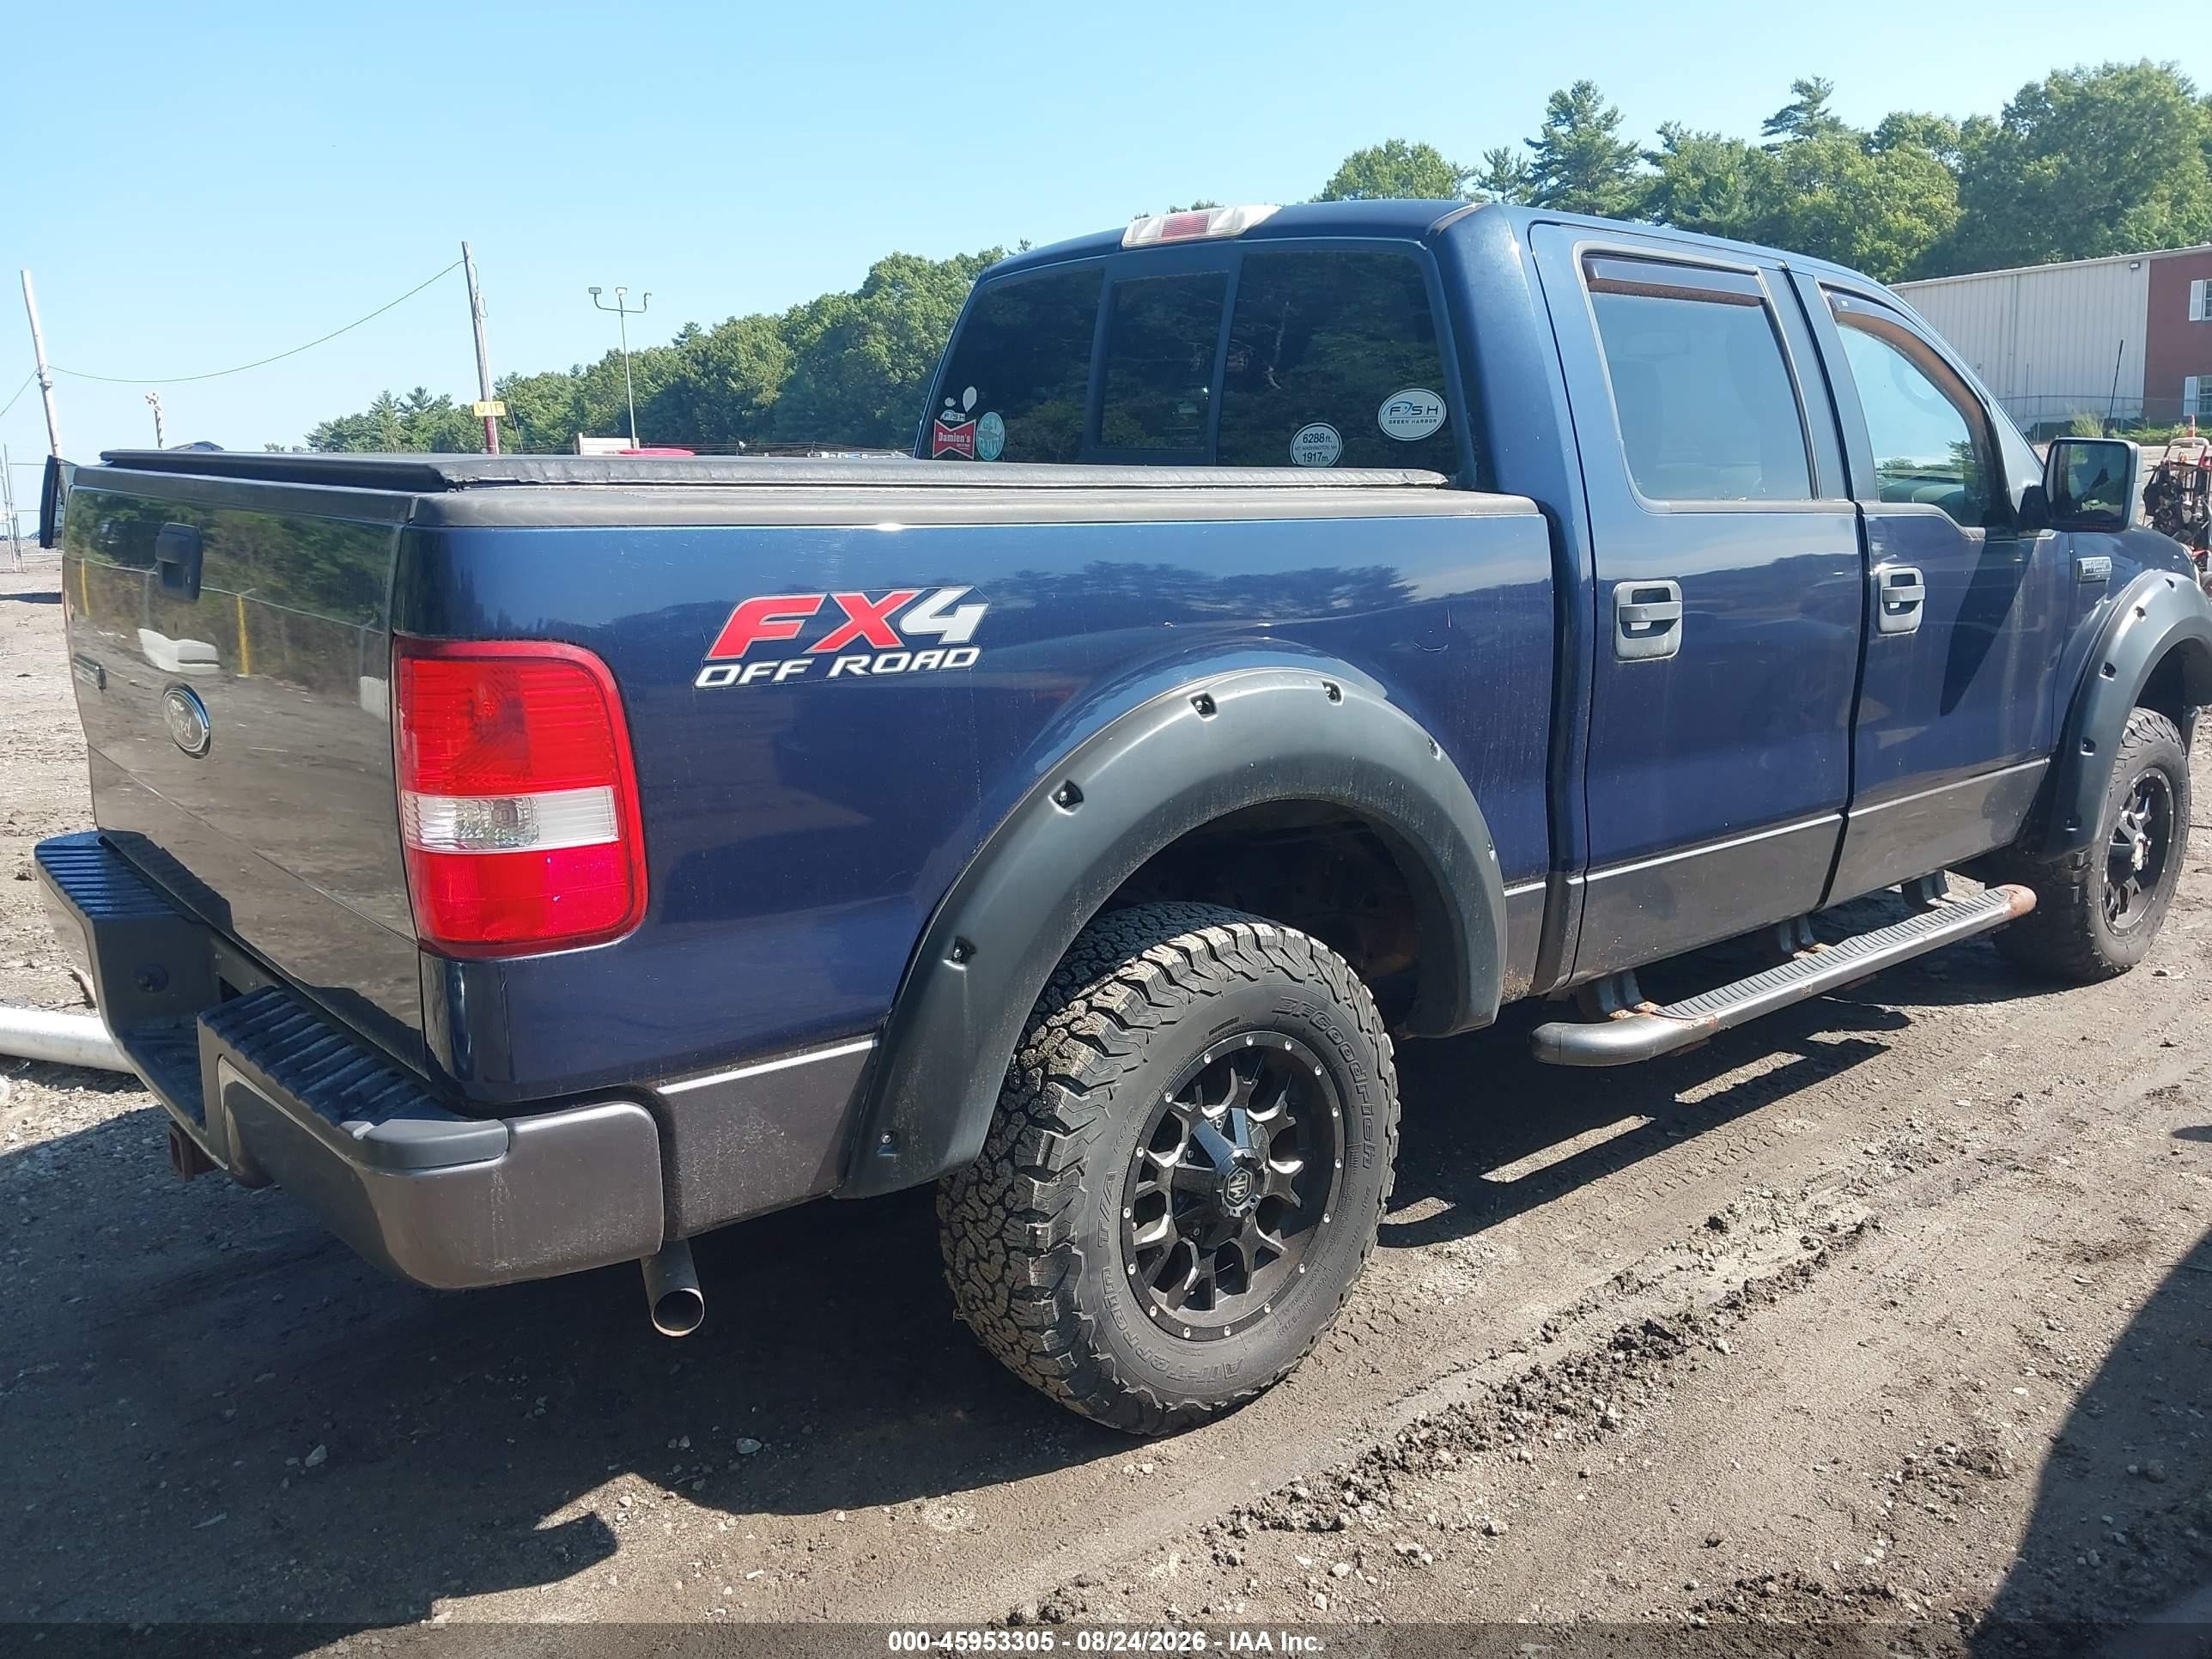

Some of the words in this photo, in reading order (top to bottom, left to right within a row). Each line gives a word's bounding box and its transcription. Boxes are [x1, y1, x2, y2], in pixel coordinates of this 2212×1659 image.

[1303, 432, 1325, 443] 6288
[704, 585, 991, 660] FX4
[694, 657, 816, 690] OFF
[826, 645, 983, 679] ROAD
